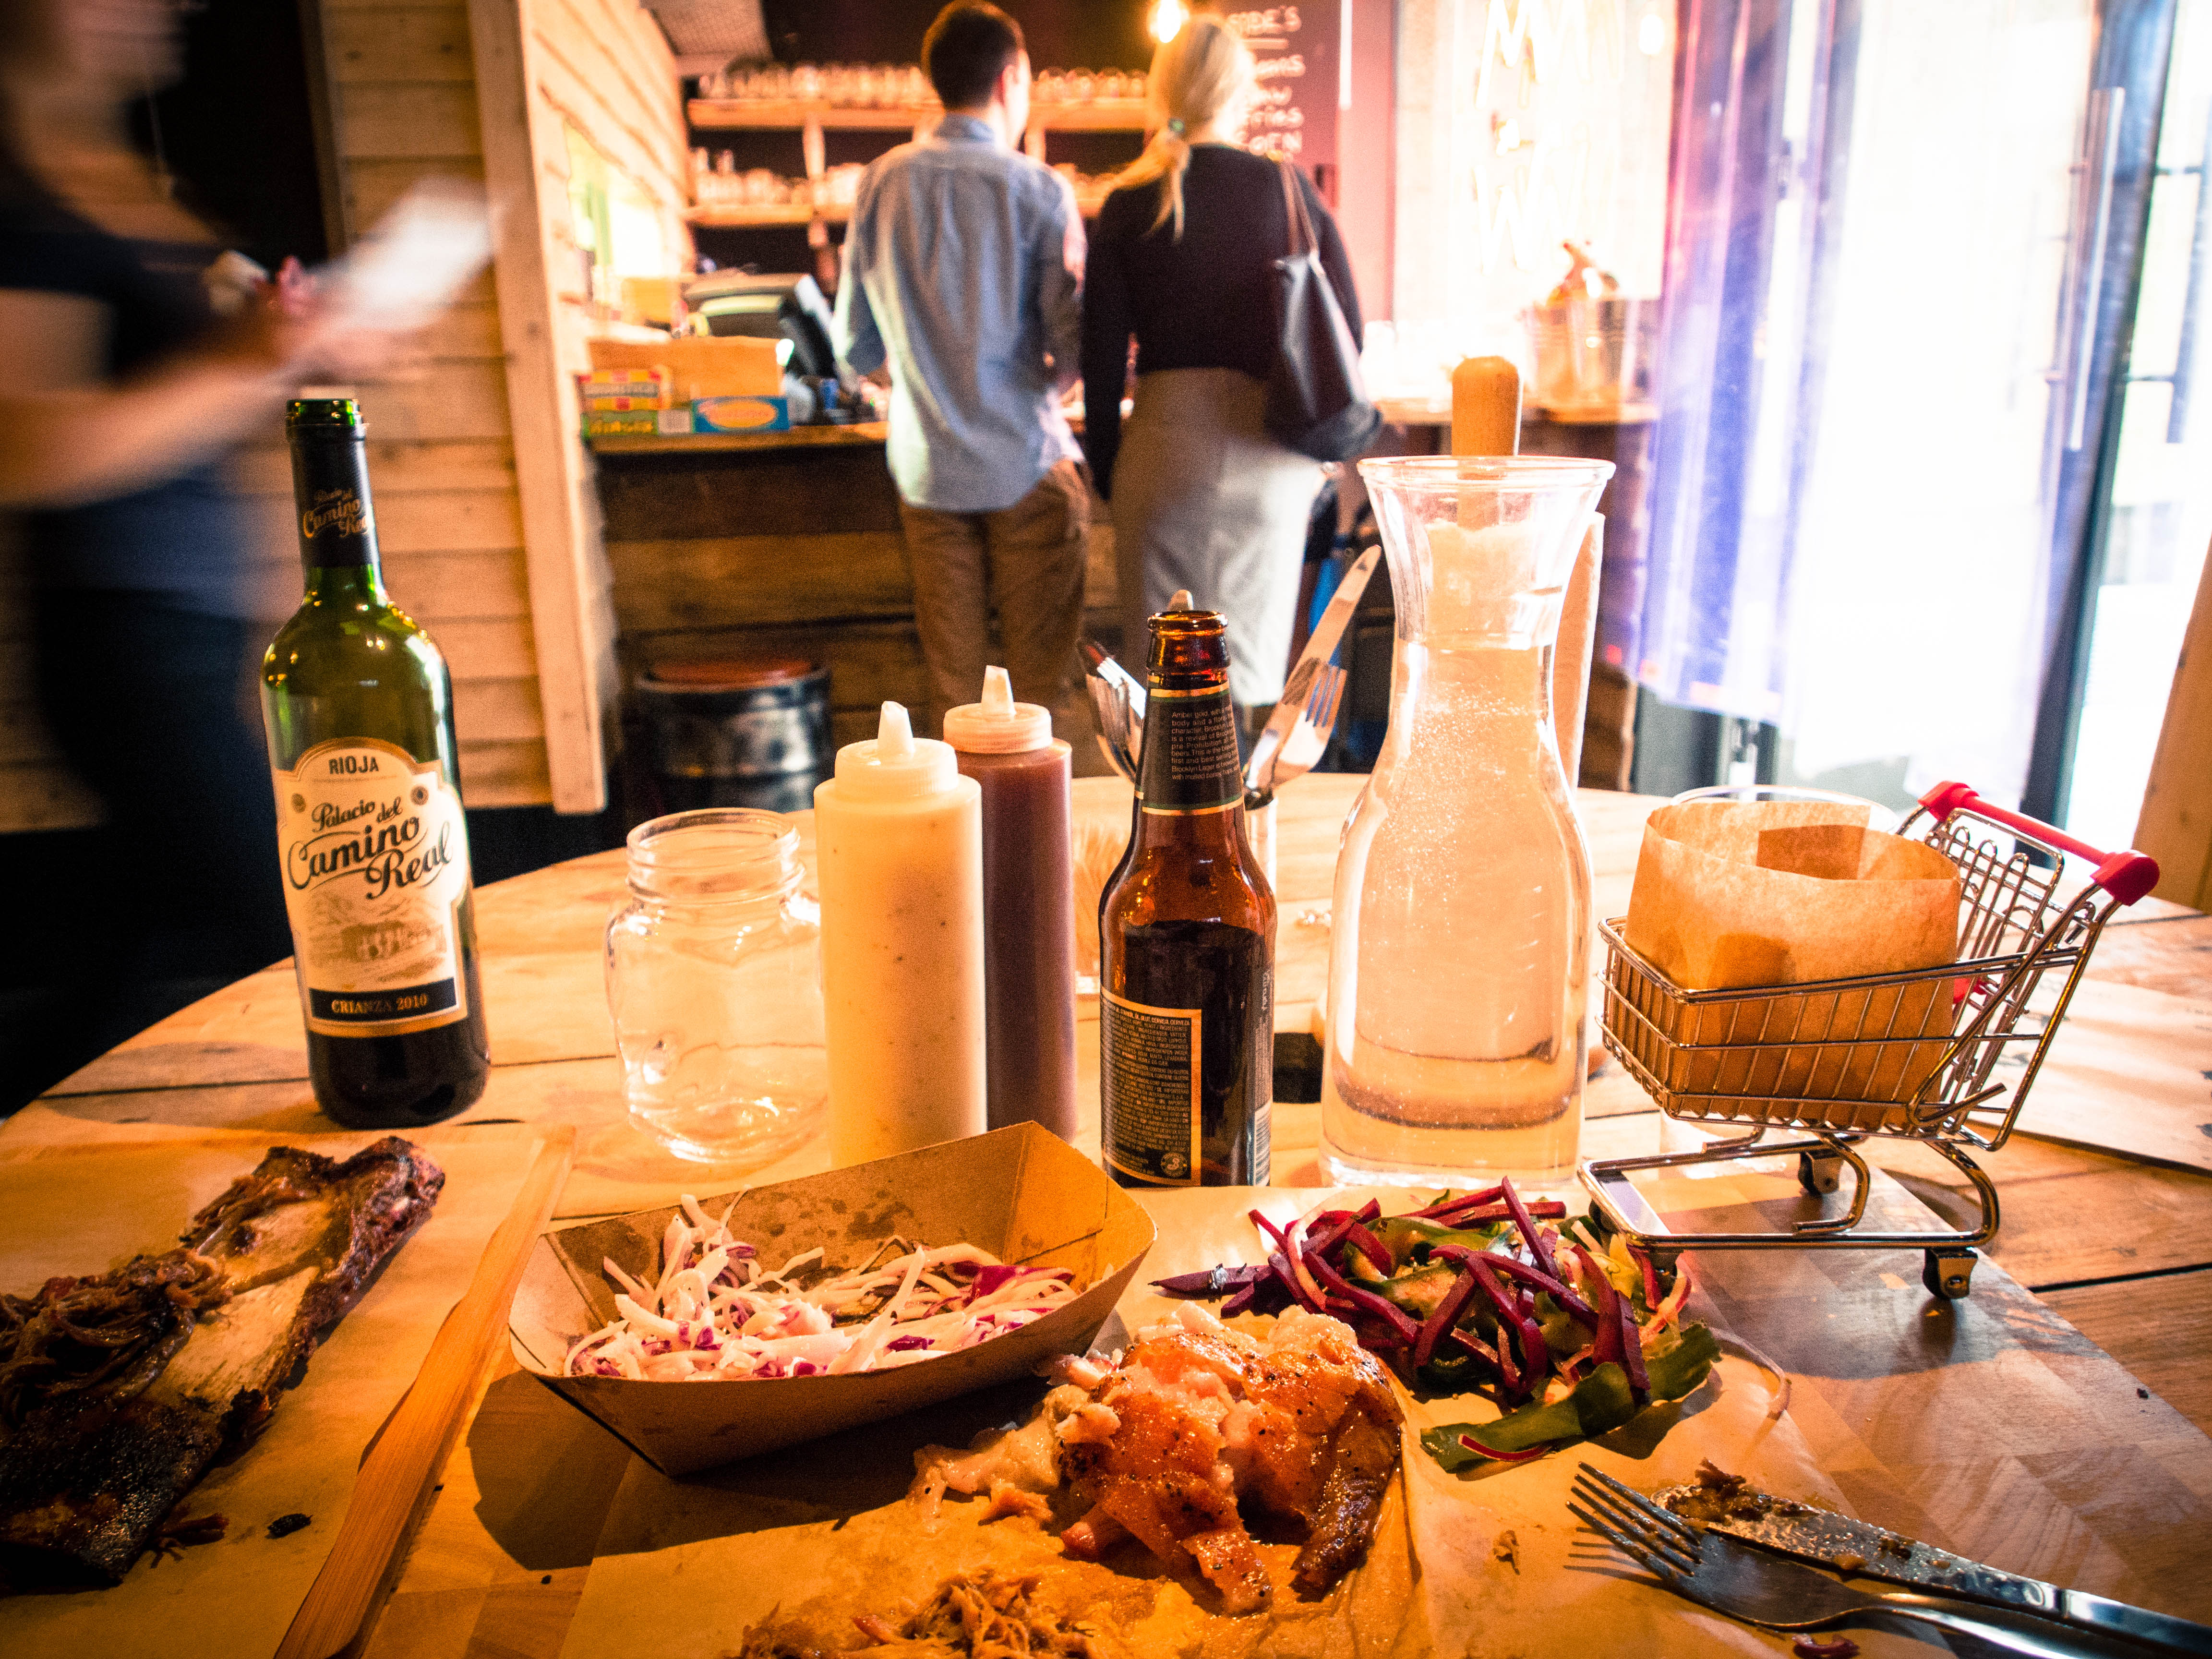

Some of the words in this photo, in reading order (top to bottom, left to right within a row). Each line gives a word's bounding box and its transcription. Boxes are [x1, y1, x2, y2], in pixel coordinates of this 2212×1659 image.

[329, 756, 379, 775] RIOJA
[1172, 765, 1197, 773] Brooklyn
[312, 799, 375, 833] Palacio
[376, 796, 403, 823] del
[288, 816, 425, 890] Camino
[362, 821, 453, 901] Real
[331, 999, 392, 1014] CRIANZA
[397, 993, 428, 1011] 2010
